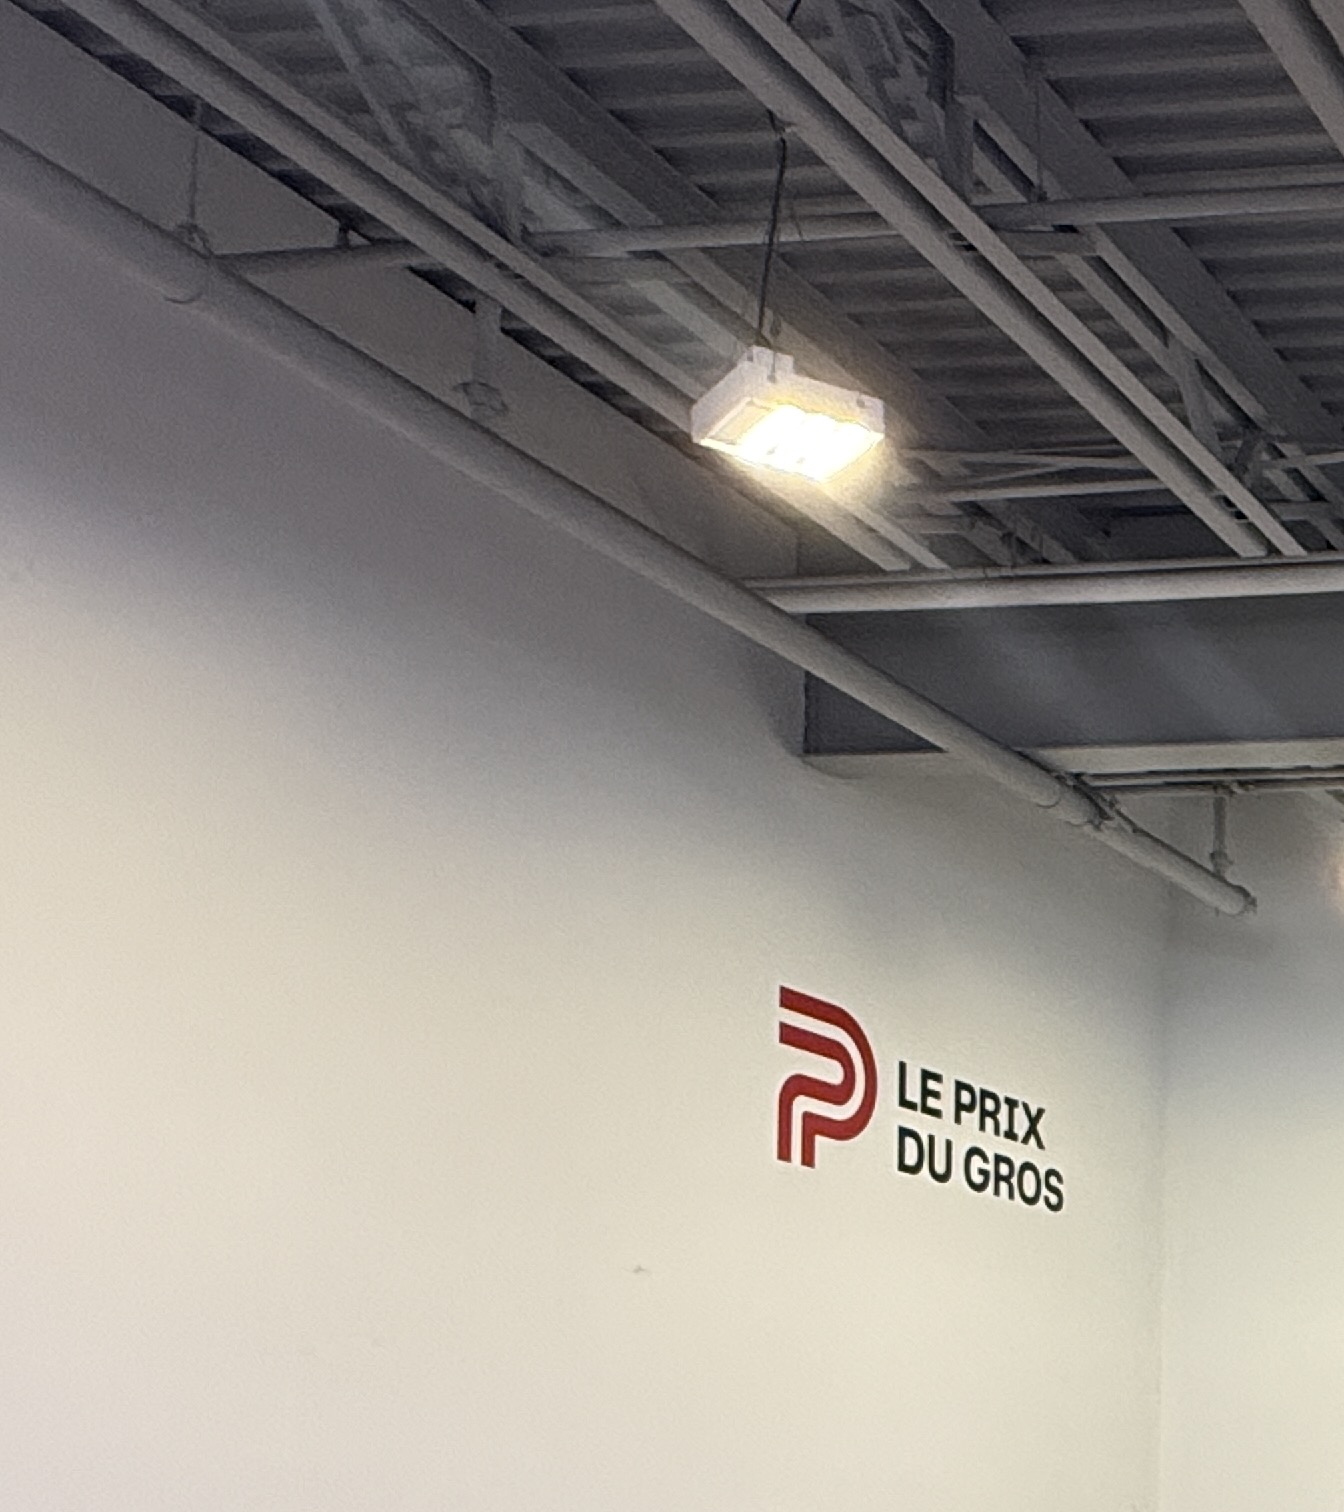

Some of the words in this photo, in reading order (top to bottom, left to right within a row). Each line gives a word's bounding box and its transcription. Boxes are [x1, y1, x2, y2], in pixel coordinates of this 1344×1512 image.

[898, 1060, 943, 1119] LE
[954, 1079, 1046, 1150] PRIX
[897, 1125, 953, 1183] DU
[964, 1146, 1064, 1213] GROS
